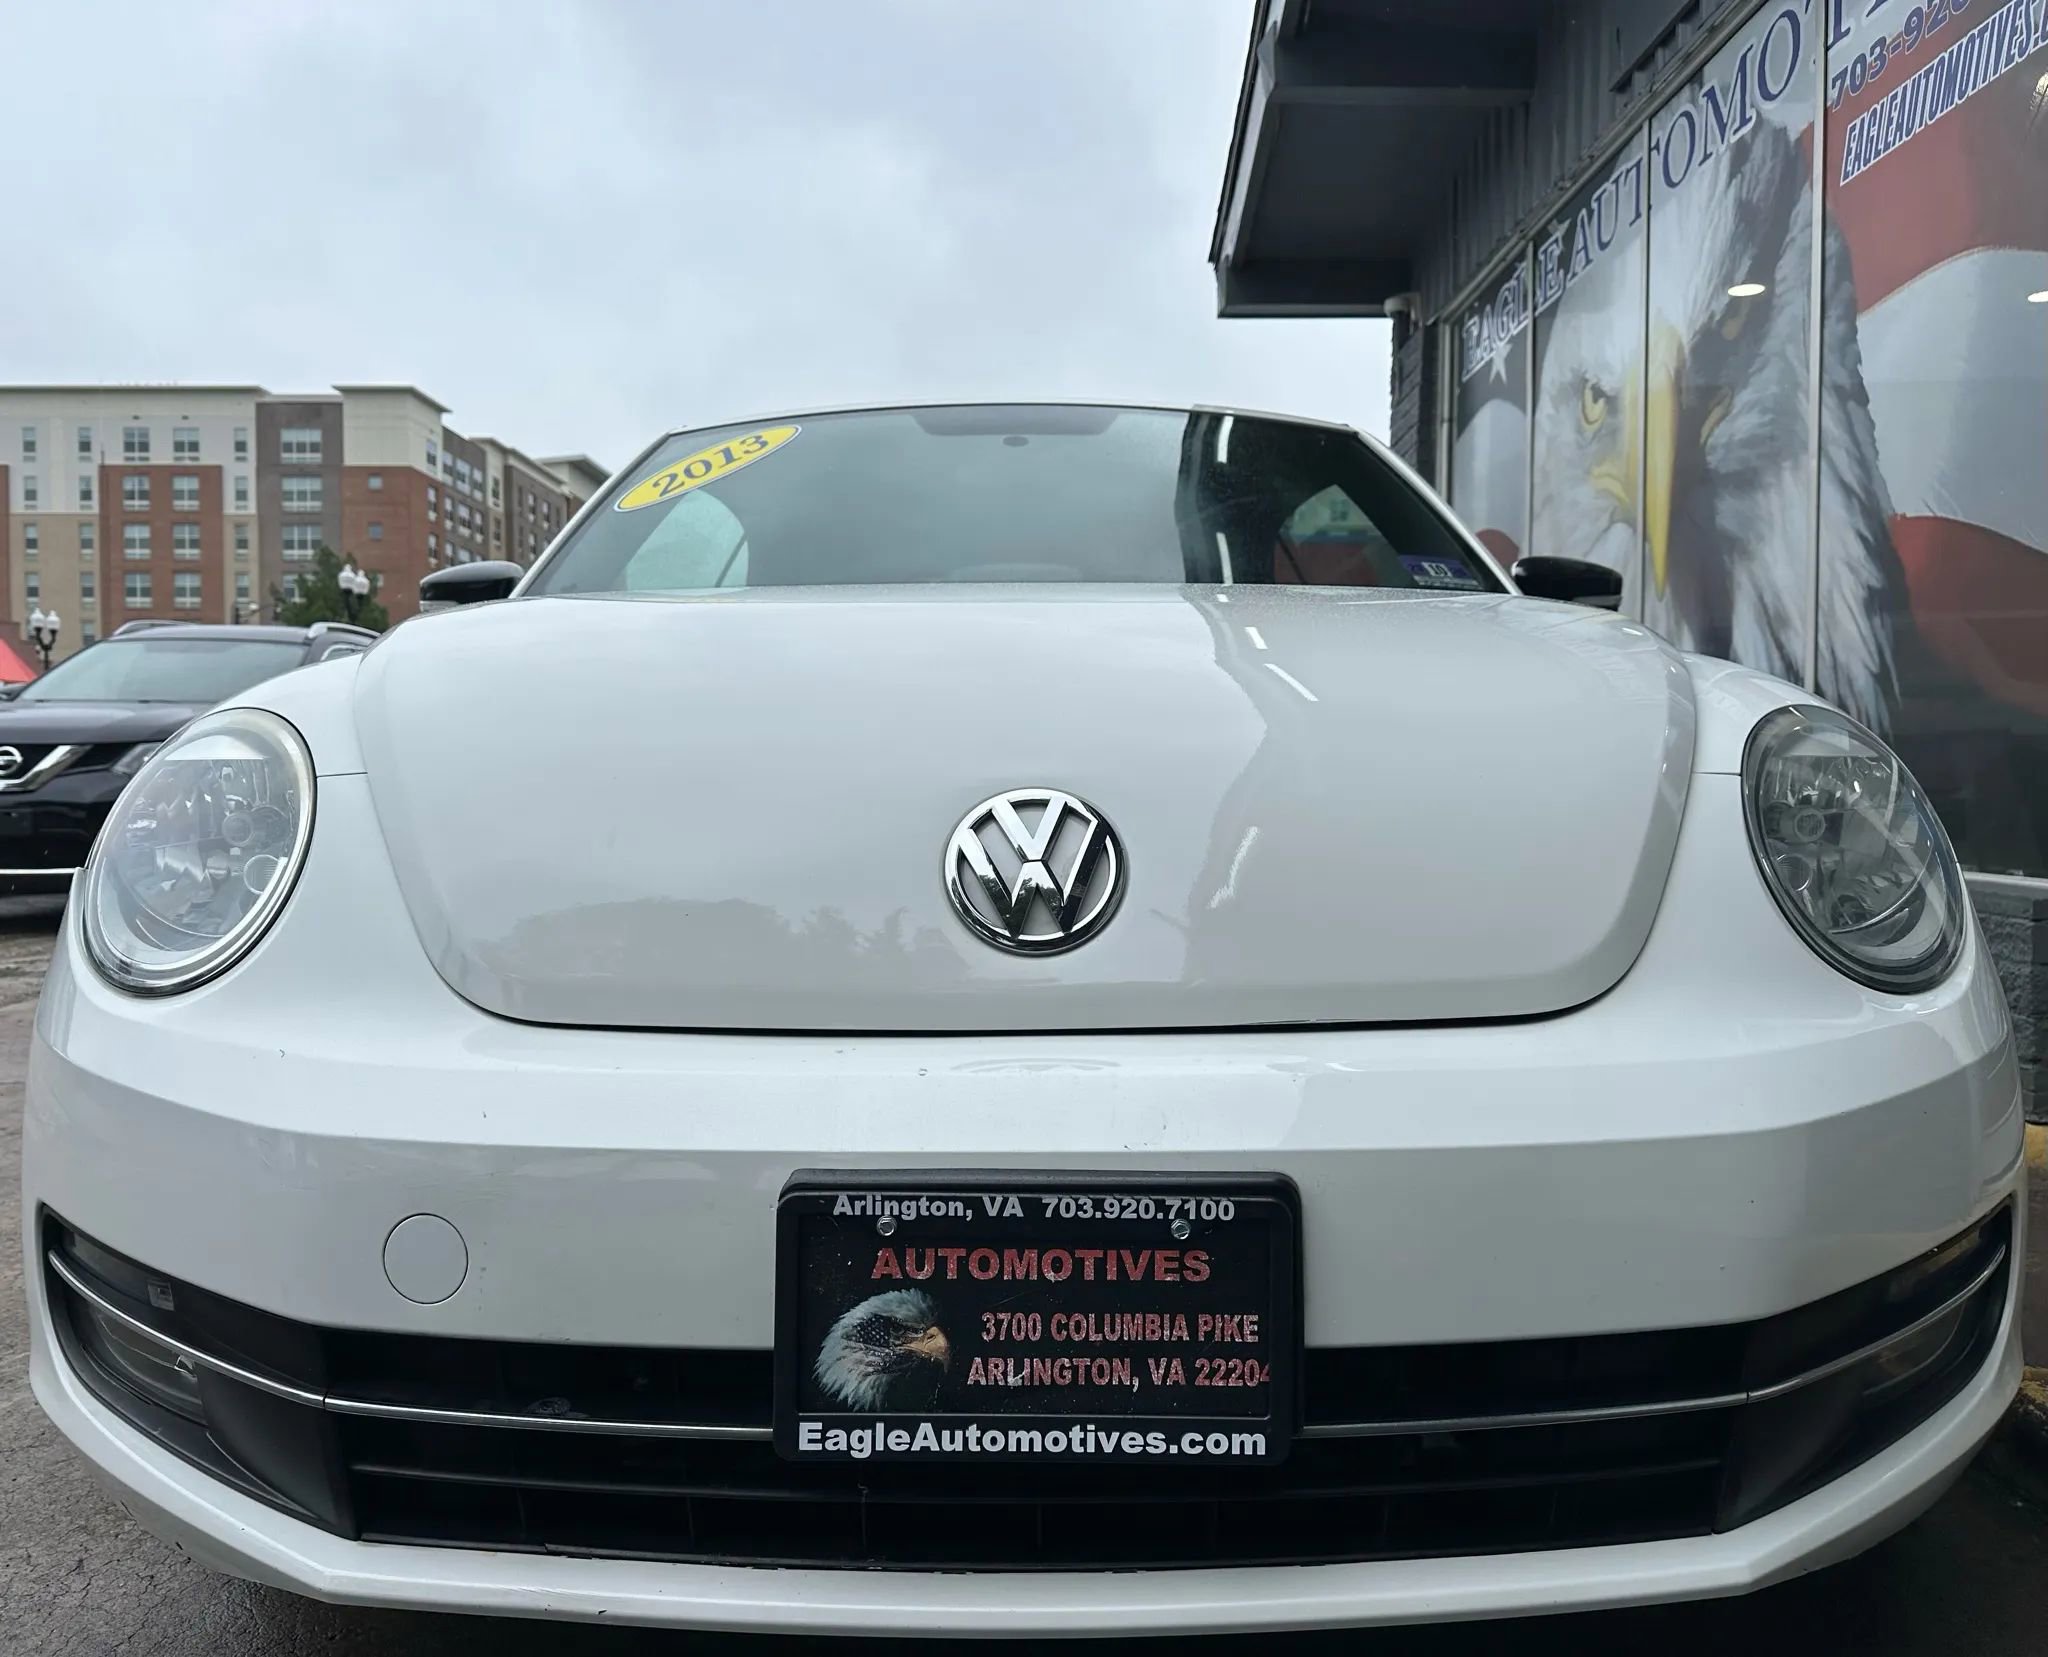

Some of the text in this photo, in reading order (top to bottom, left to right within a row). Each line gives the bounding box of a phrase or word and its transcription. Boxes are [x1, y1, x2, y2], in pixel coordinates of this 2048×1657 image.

[1840, 0, 2048, 187] EAGLEAUTOMOTIVES.
[1462, 230, 1565, 383] EAGLE
[652, 435, 768, 497] 2013
[833, 1193, 1236, 1222] Arlington, VA 703.920.7100
[871, 1248, 1212, 1283] AUTOMOTIVES
[981, 1312, 1260, 1343] 3700 COLUMBIA PIKE
[967, 1356, 1140, 1393] ARLINGTON,
[1147, 1357, 1187, 1386] VA
[798, 1421, 1267, 1459] EagleAutomotives.com
